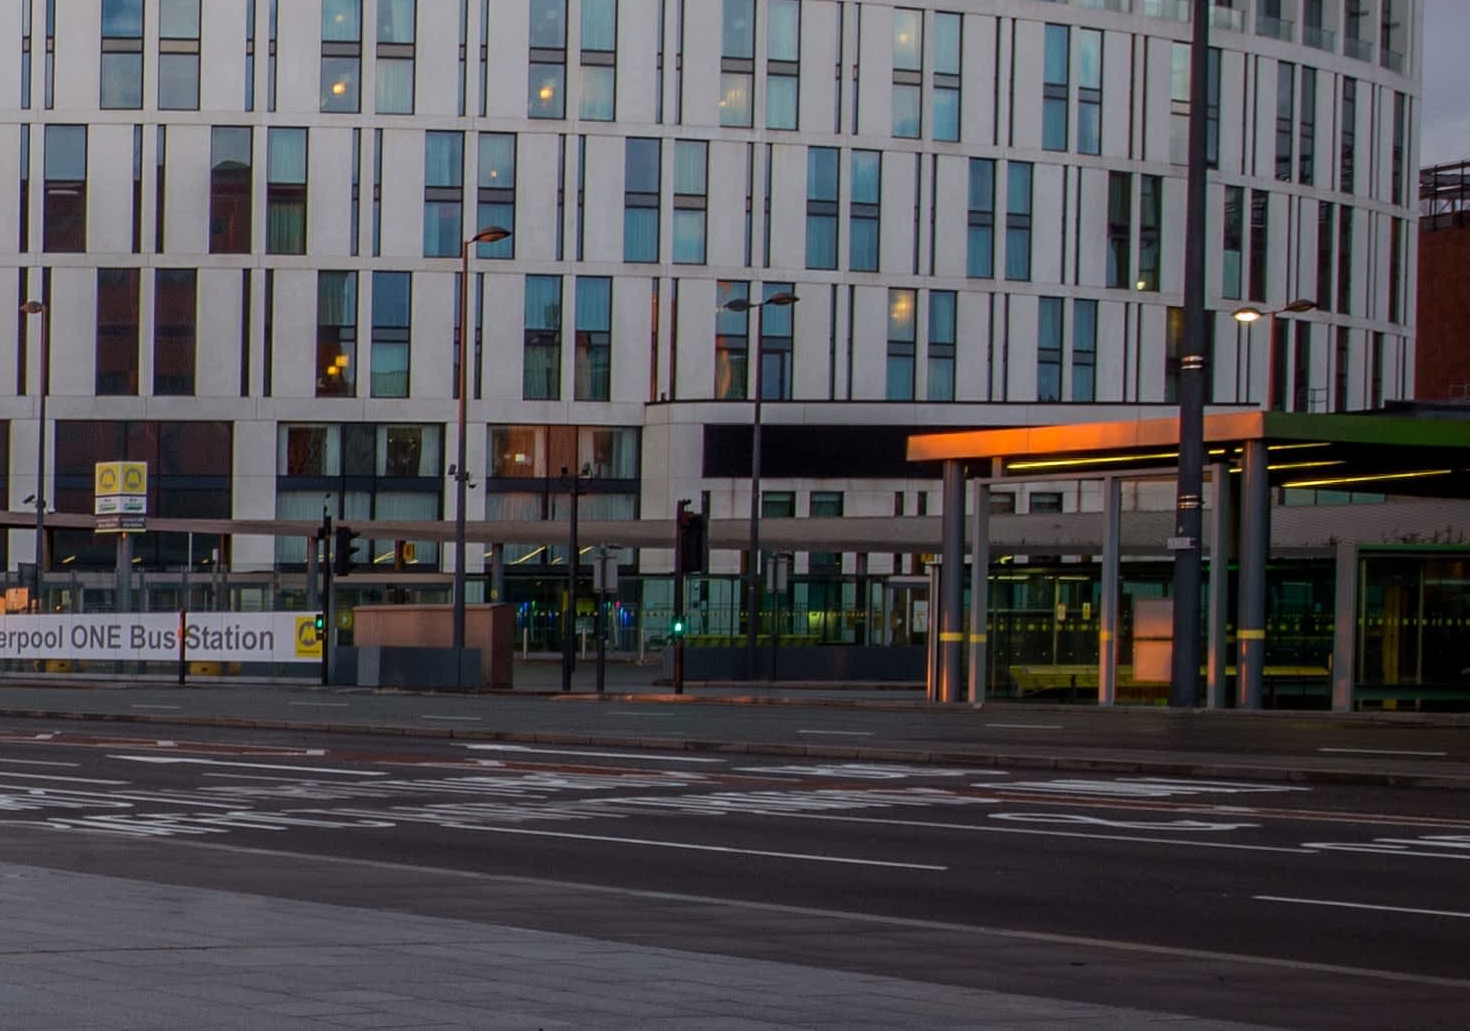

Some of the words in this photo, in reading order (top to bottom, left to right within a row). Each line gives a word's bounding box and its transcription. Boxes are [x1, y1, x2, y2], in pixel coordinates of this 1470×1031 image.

[71, 624, 122, 650] ONE
[130, 624, 177, 650] Bus
[185, 624, 274, 651] Station
